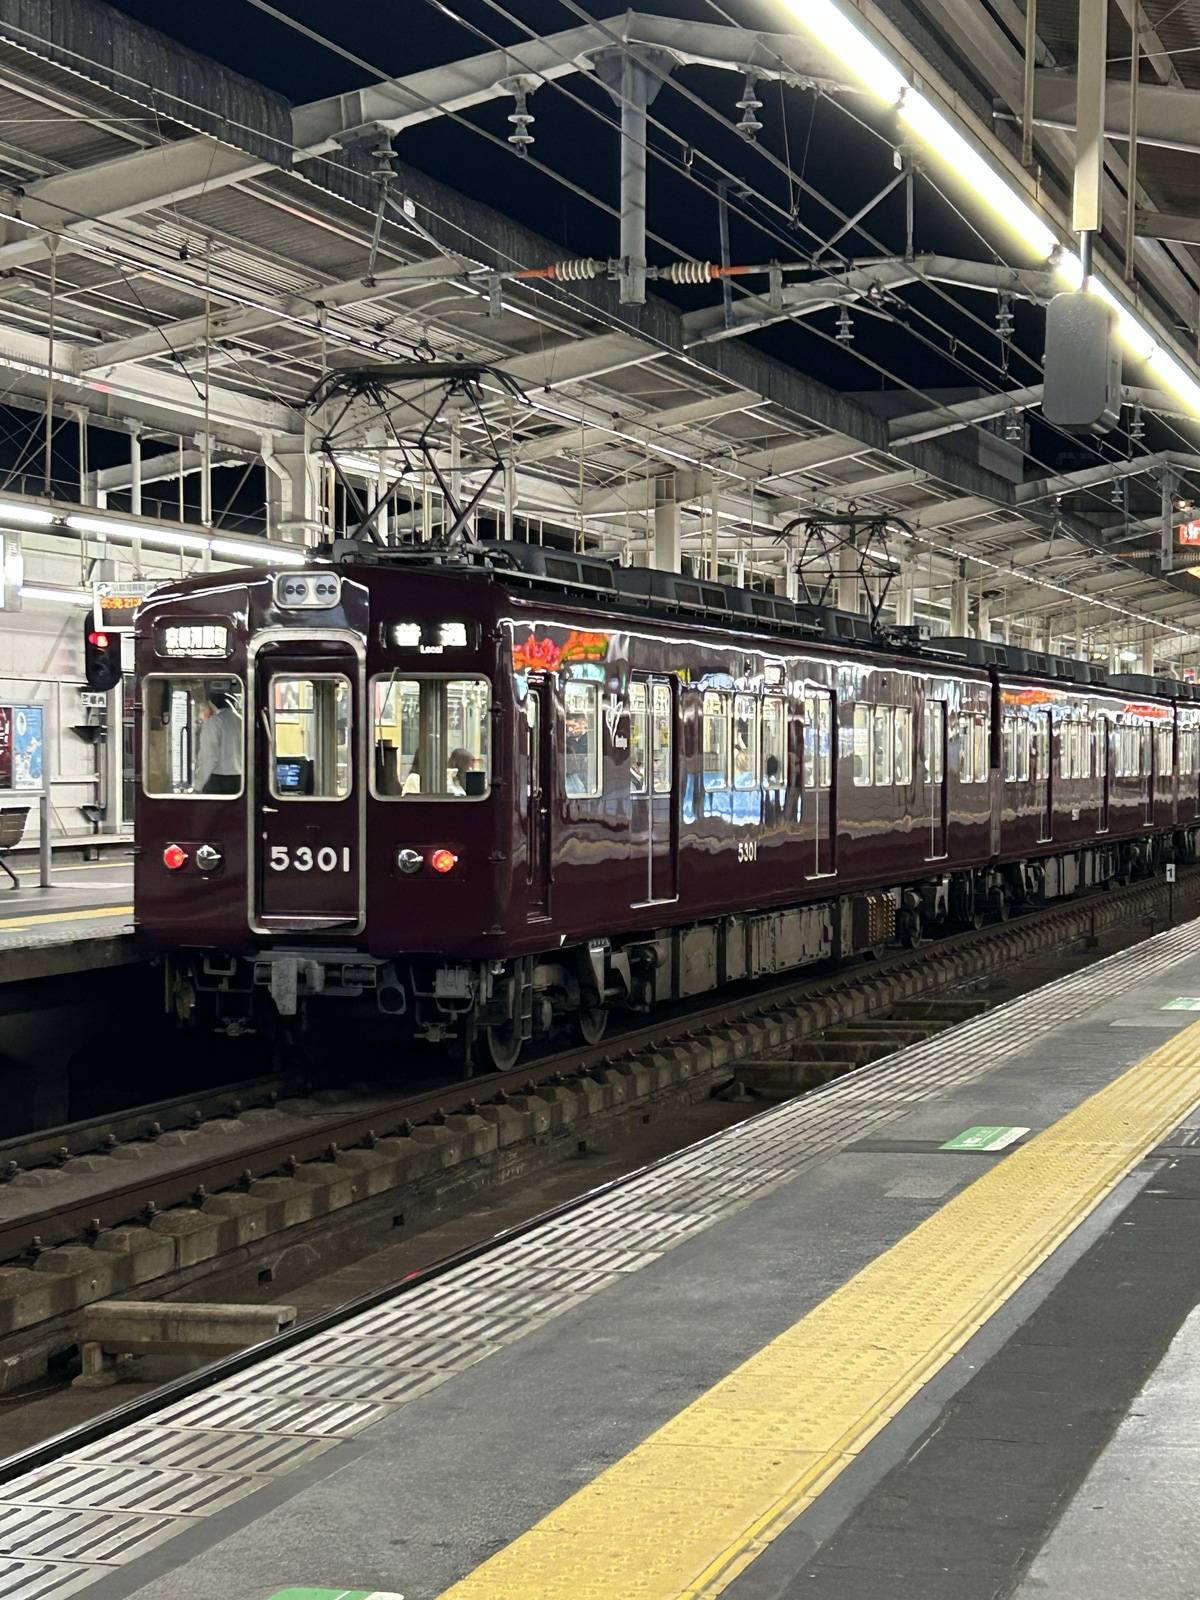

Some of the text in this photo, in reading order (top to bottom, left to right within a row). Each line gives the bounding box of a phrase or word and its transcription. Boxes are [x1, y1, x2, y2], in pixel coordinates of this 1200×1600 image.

[420, 644, 444, 654] Local
[269, 846, 350, 872] 5301
[737, 841, 757, 863] 5301
